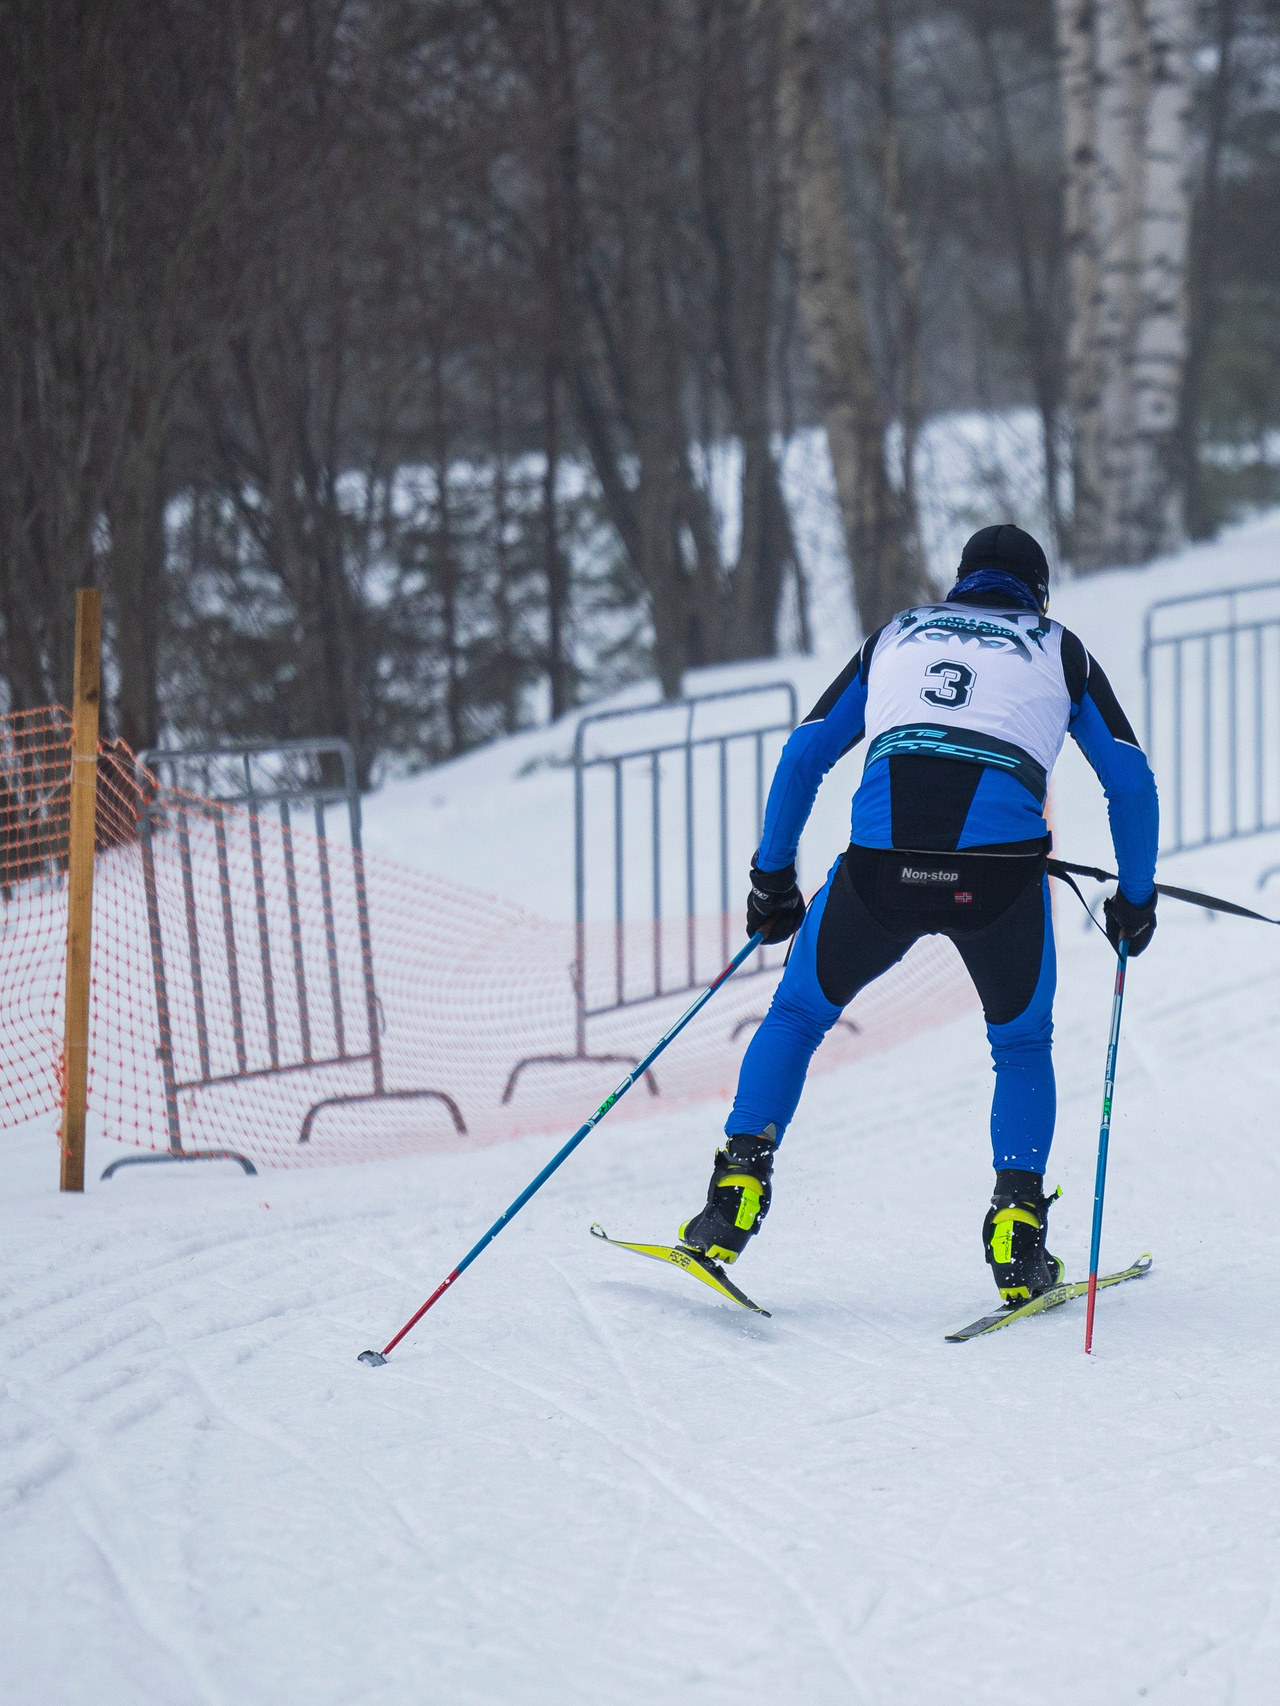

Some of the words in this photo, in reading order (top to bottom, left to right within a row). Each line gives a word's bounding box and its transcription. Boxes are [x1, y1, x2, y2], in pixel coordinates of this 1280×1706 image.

[920, 659, 977, 711] 3
[902, 867, 959, 881] Non-stop
[668, 1250, 692, 1269] FISCHER
